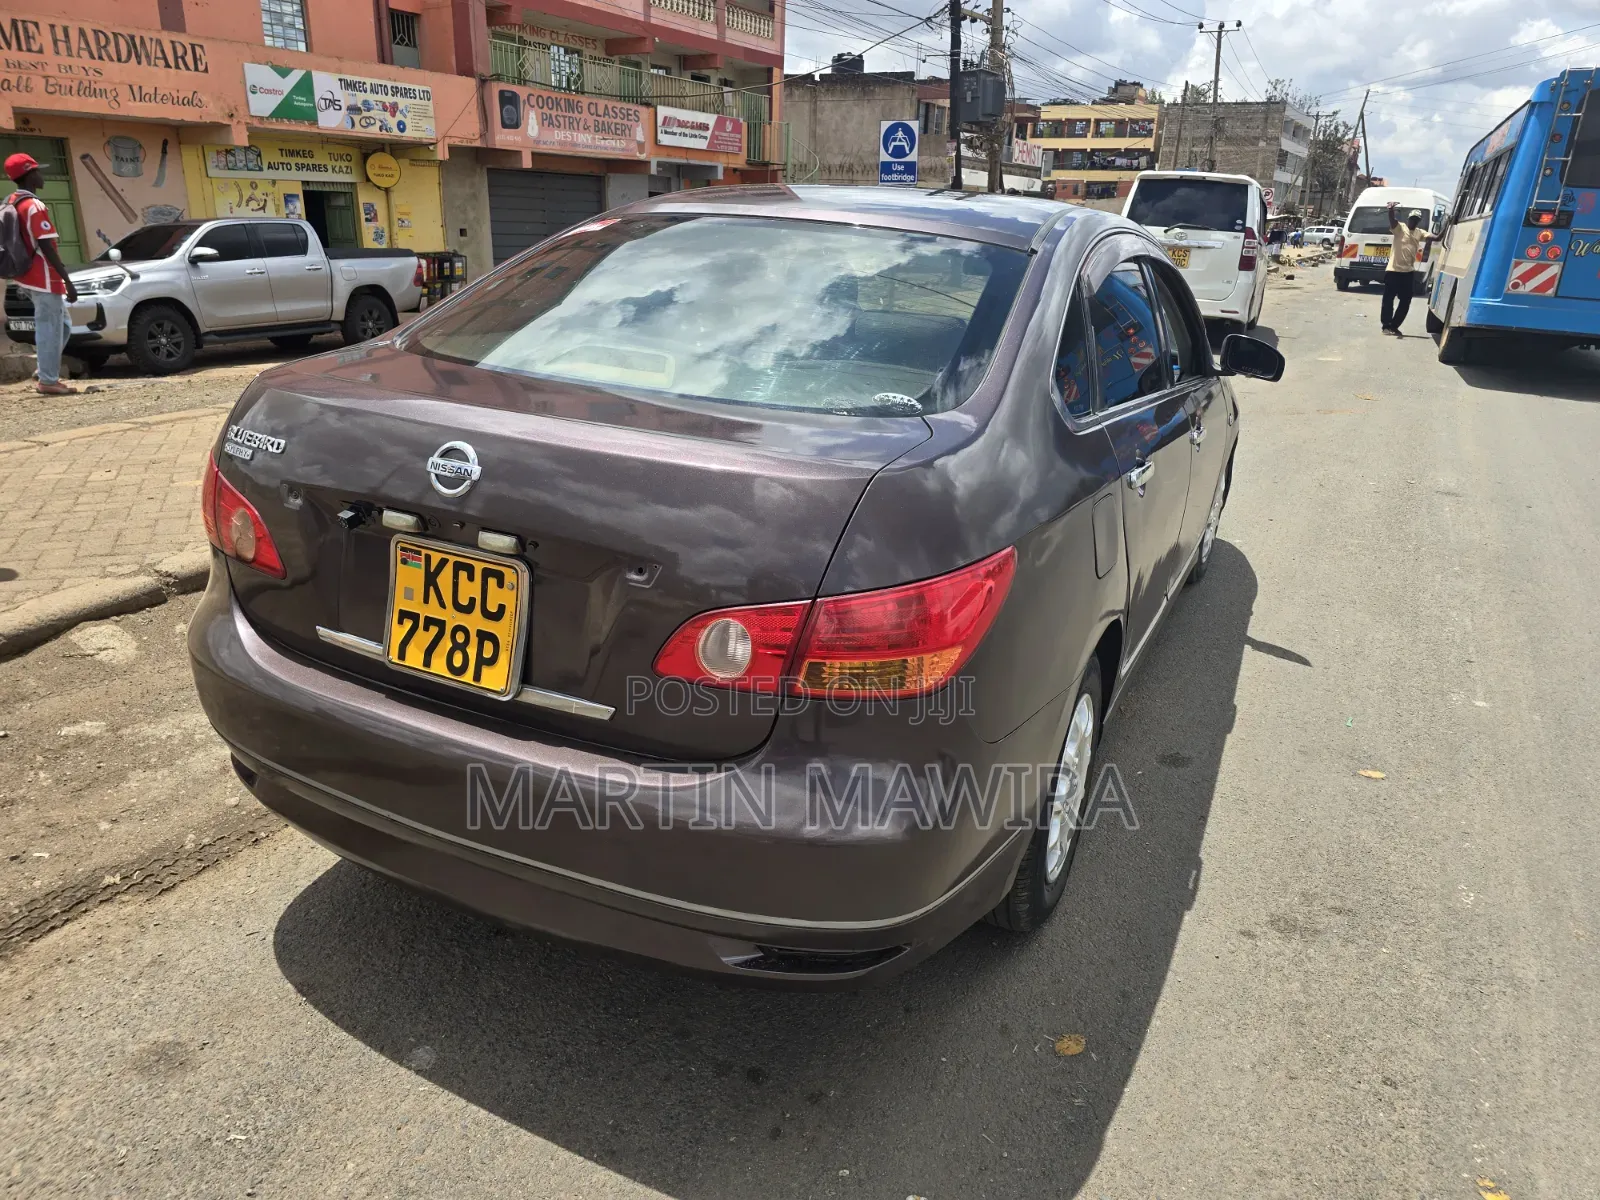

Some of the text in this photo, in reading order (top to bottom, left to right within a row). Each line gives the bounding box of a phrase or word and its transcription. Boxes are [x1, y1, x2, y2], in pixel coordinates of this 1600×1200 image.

[550, 30, 598, 50] CLASSES
[48, 24, 209, 74] HARDWARE
[4, 58, 104, 77] BEST BUYS
[43, 75, 119, 110] Building
[259, 86, 285, 96] Castrol
[338, 78, 432, 102] TIMKEG AUTO SPARES LTD
[526, 93, 640, 123] COOKING CLASSES
[541, 112, 633, 138] PASTRY & BAKERY
[554, 130, 593, 144] DESTINY
[115, 155, 140, 163] PAINT
[278, 148, 314, 159] TIMKEG
[328, 152, 353, 163] TUKO
[1014, 140, 1042, 164] CHEMIST
[267, 161, 328, 173] AUTO SPARES
[331, 165, 353, 175] KAZI
[892, 163, 905, 171] Use
[881, 172, 915, 182] footbridge
[1171, 248, 1187, 258] KCS
[429, 461, 474, 478] NISSAN
[422, 553, 506, 622] KCC
[396, 608, 501, 683] 778P
